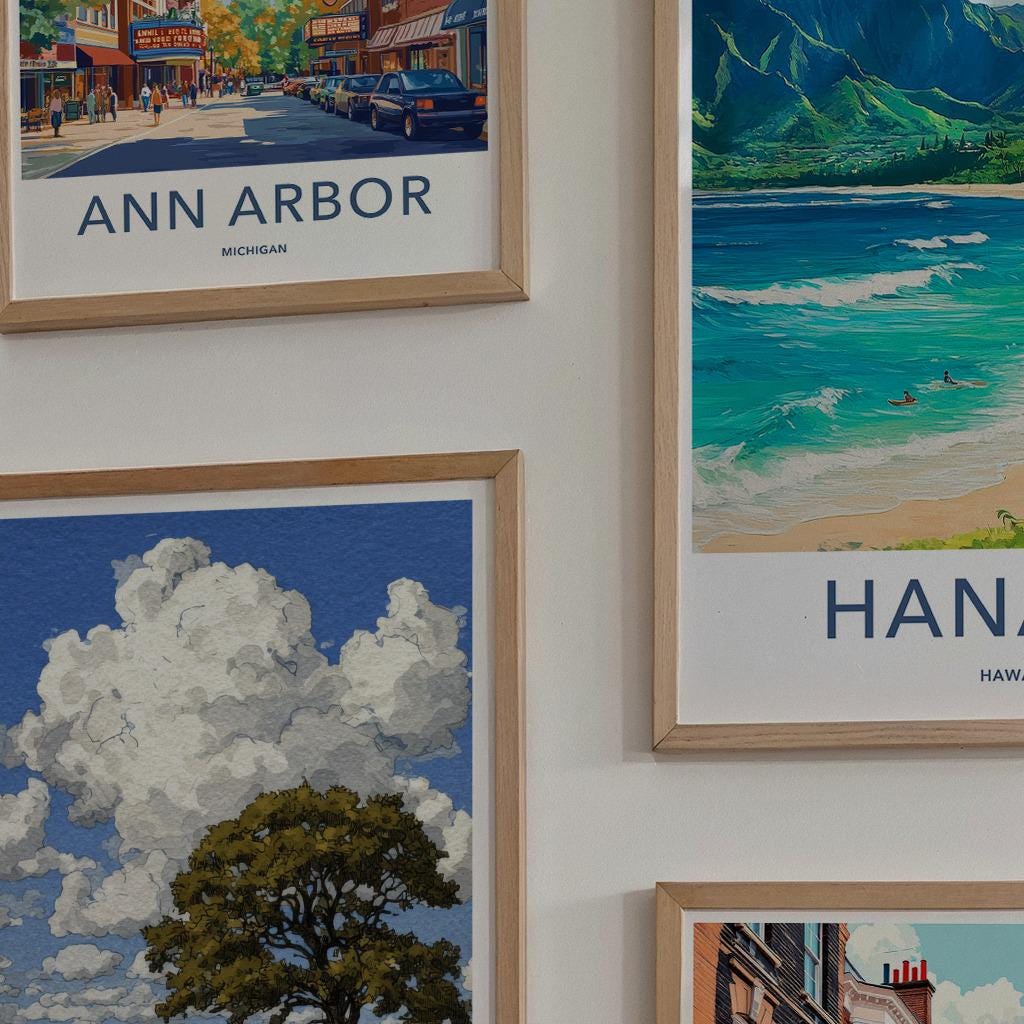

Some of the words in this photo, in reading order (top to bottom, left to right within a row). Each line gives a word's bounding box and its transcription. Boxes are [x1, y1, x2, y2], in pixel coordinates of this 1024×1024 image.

[77, 189, 204, 236] ANN
[228, 175, 432, 227] ARBOR
[221, 243, 287, 257] MICHIGAN
[826, 577, 1024, 639] HAN
[980, 668, 1024, 682] HAW
